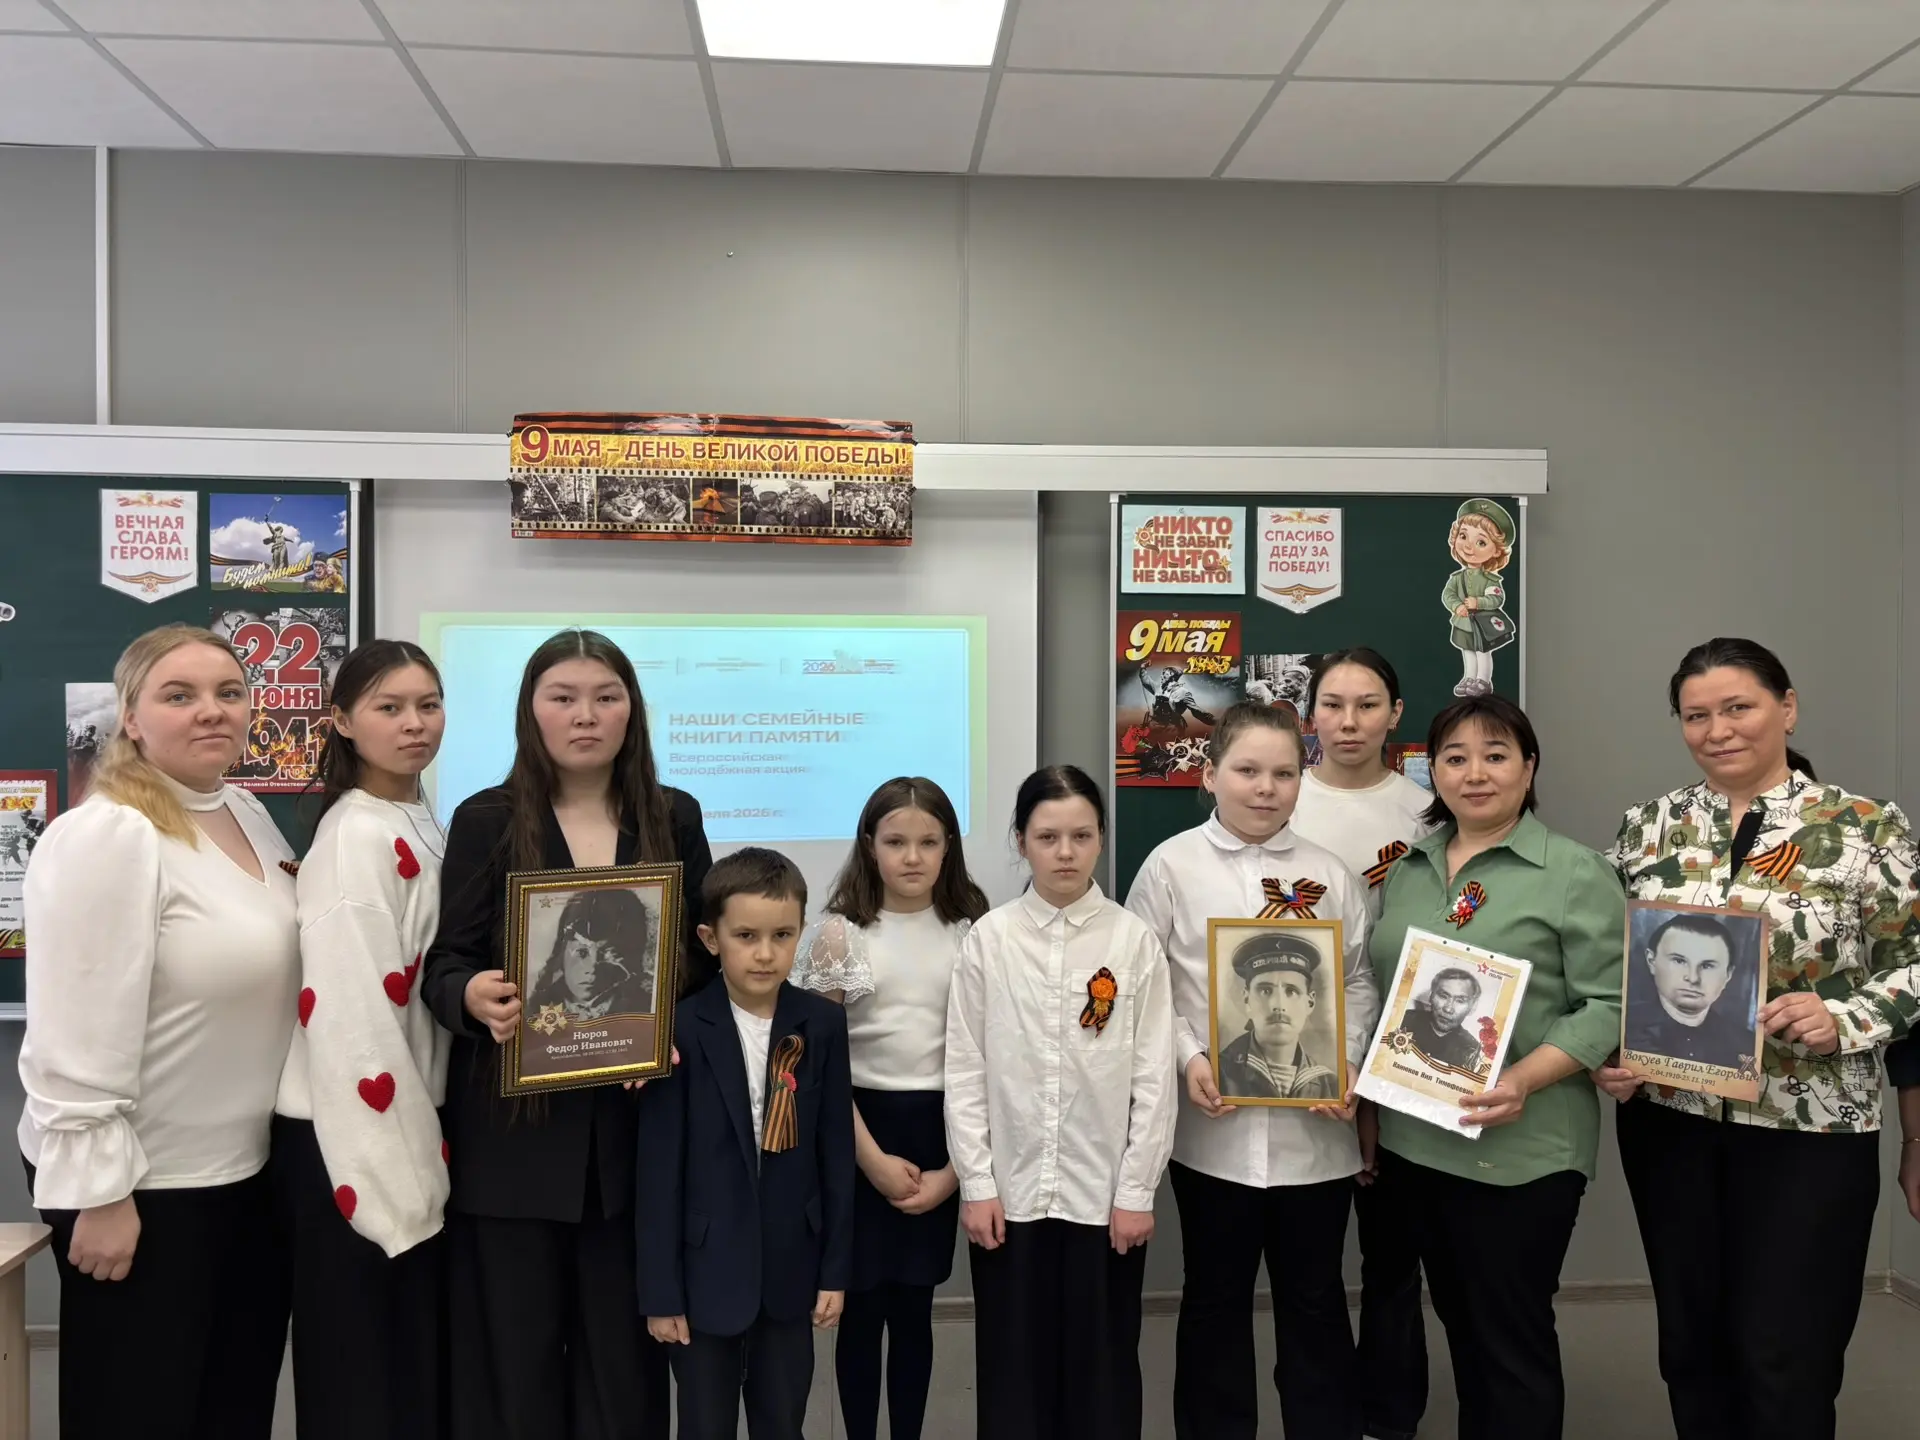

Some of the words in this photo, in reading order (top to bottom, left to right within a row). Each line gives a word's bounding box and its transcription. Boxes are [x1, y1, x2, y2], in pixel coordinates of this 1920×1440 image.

[520, 424, 550, 463] 9
[553, 439, 600, 457] МАЯ
[625, 441, 685, 462] ДЕНЬ
[695, 438, 798, 463] ВЕЛИКОЙ
[805, 445, 907, 467] ПОБЕДЫ!
[115, 515, 184, 529] ВЕЧНАЯ
[1153, 516, 1233, 534] НИКТО
[118, 530, 181, 545] СЛАВА
[1155, 536, 1173, 547] НЕ
[1176, 536, 1233, 549] ЗАБЫТ,
[1264, 530, 1335, 542] СПАСИБО
[110, 546, 188, 561] ГЕРОЯМ!
[1133, 550, 1220, 569] НИЧТО
[1270, 546, 1308, 558] ДЕДУ
[1311, 546, 1329, 557] ЗА
[223, 562, 266, 587] Будем
[1269, 561, 1330, 574] ПОБЕДУ!
[1133, 570, 1155, 583] НЕ
[1158, 570, 1232, 583] ЗАБЫТО!
[1161, 620, 1188, 630] ДЕНЬ
[1189, 620, 1232, 630] ПОБЕДЫ
[1125, 619, 1158, 661] 9
[231, 622, 321, 685] 22
[251, 686, 322, 709] ЮНЯ
[669, 713, 736, 726] НАШИ
[742, 709, 864, 726] СЕМЕЙНЫЕ
[669, 731, 742, 745] КНИГИ
[750, 730, 841, 744] ПАМЯТИ
[240, 717, 333, 779] 941
[669, 752, 785, 764] Всероссийская
[668, 764, 760, 776] молодёжная
[764, 766, 807, 775] акция
[573, 1030, 608, 1040] Нюров
[546, 1044, 579, 1054] Федор
[581, 1038, 633, 1050] Иванович
[1623, 1050, 1661, 1066] Вокуев
[1664, 1057, 1704, 1074] Гаврил
